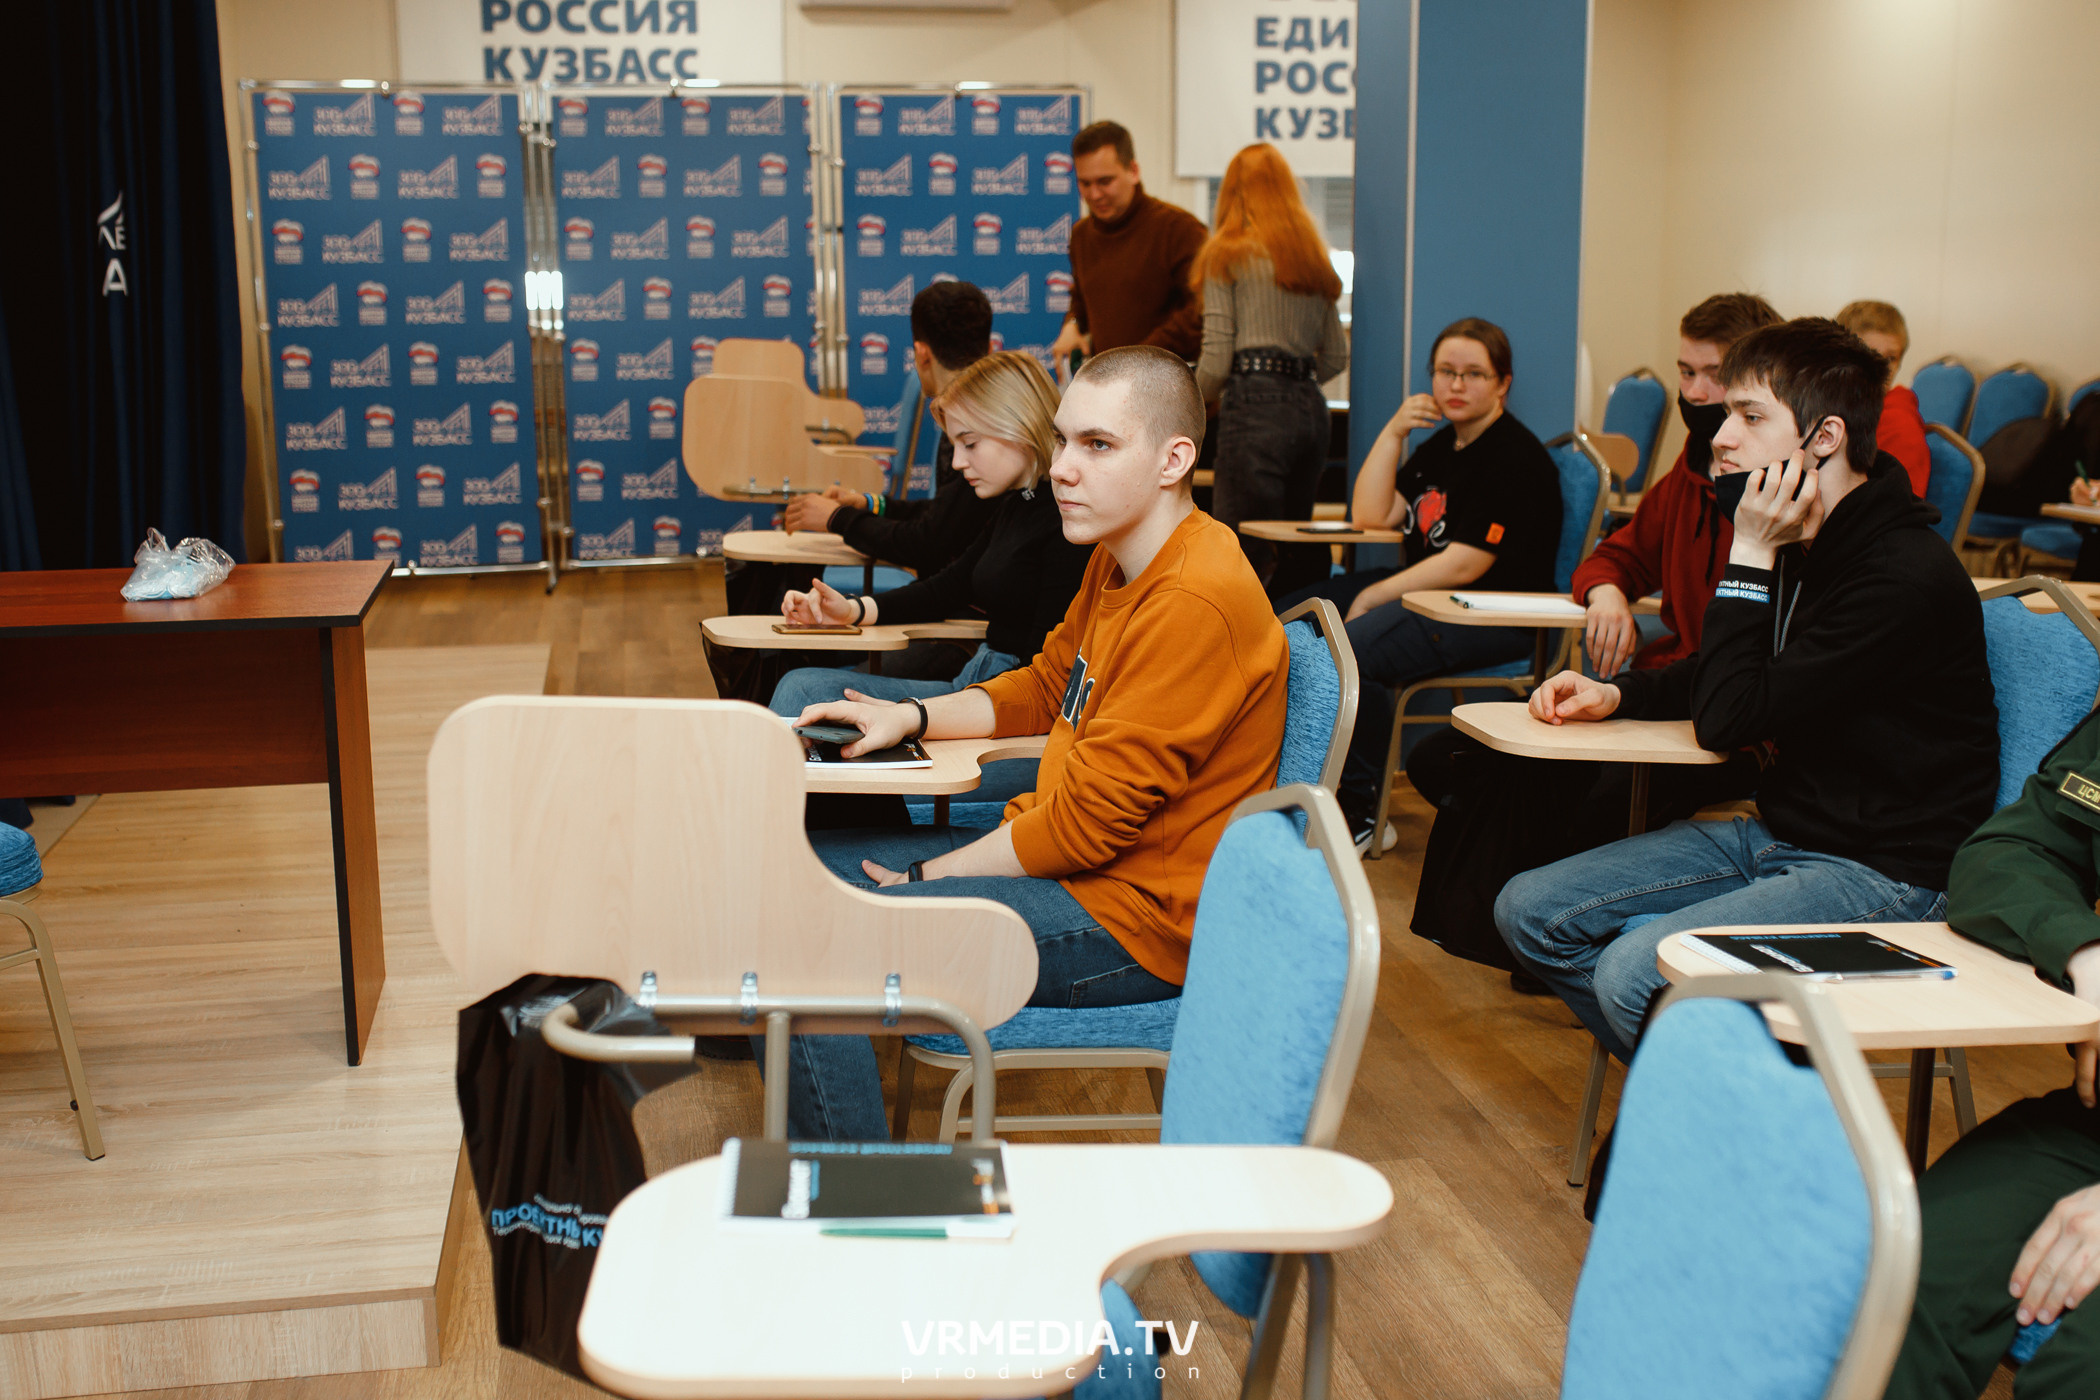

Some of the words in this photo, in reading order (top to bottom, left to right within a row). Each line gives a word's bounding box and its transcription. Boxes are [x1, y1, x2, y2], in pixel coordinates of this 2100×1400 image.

[482, 0, 698, 33] РОССИЯ
[483, 47, 698, 82] КУЗБАСС
[1256, 61, 1357, 94] РОС
[1739, 590, 1768, 601] КУЗБАСС
[1740, 582, 1769, 592] КУЗБАСС
